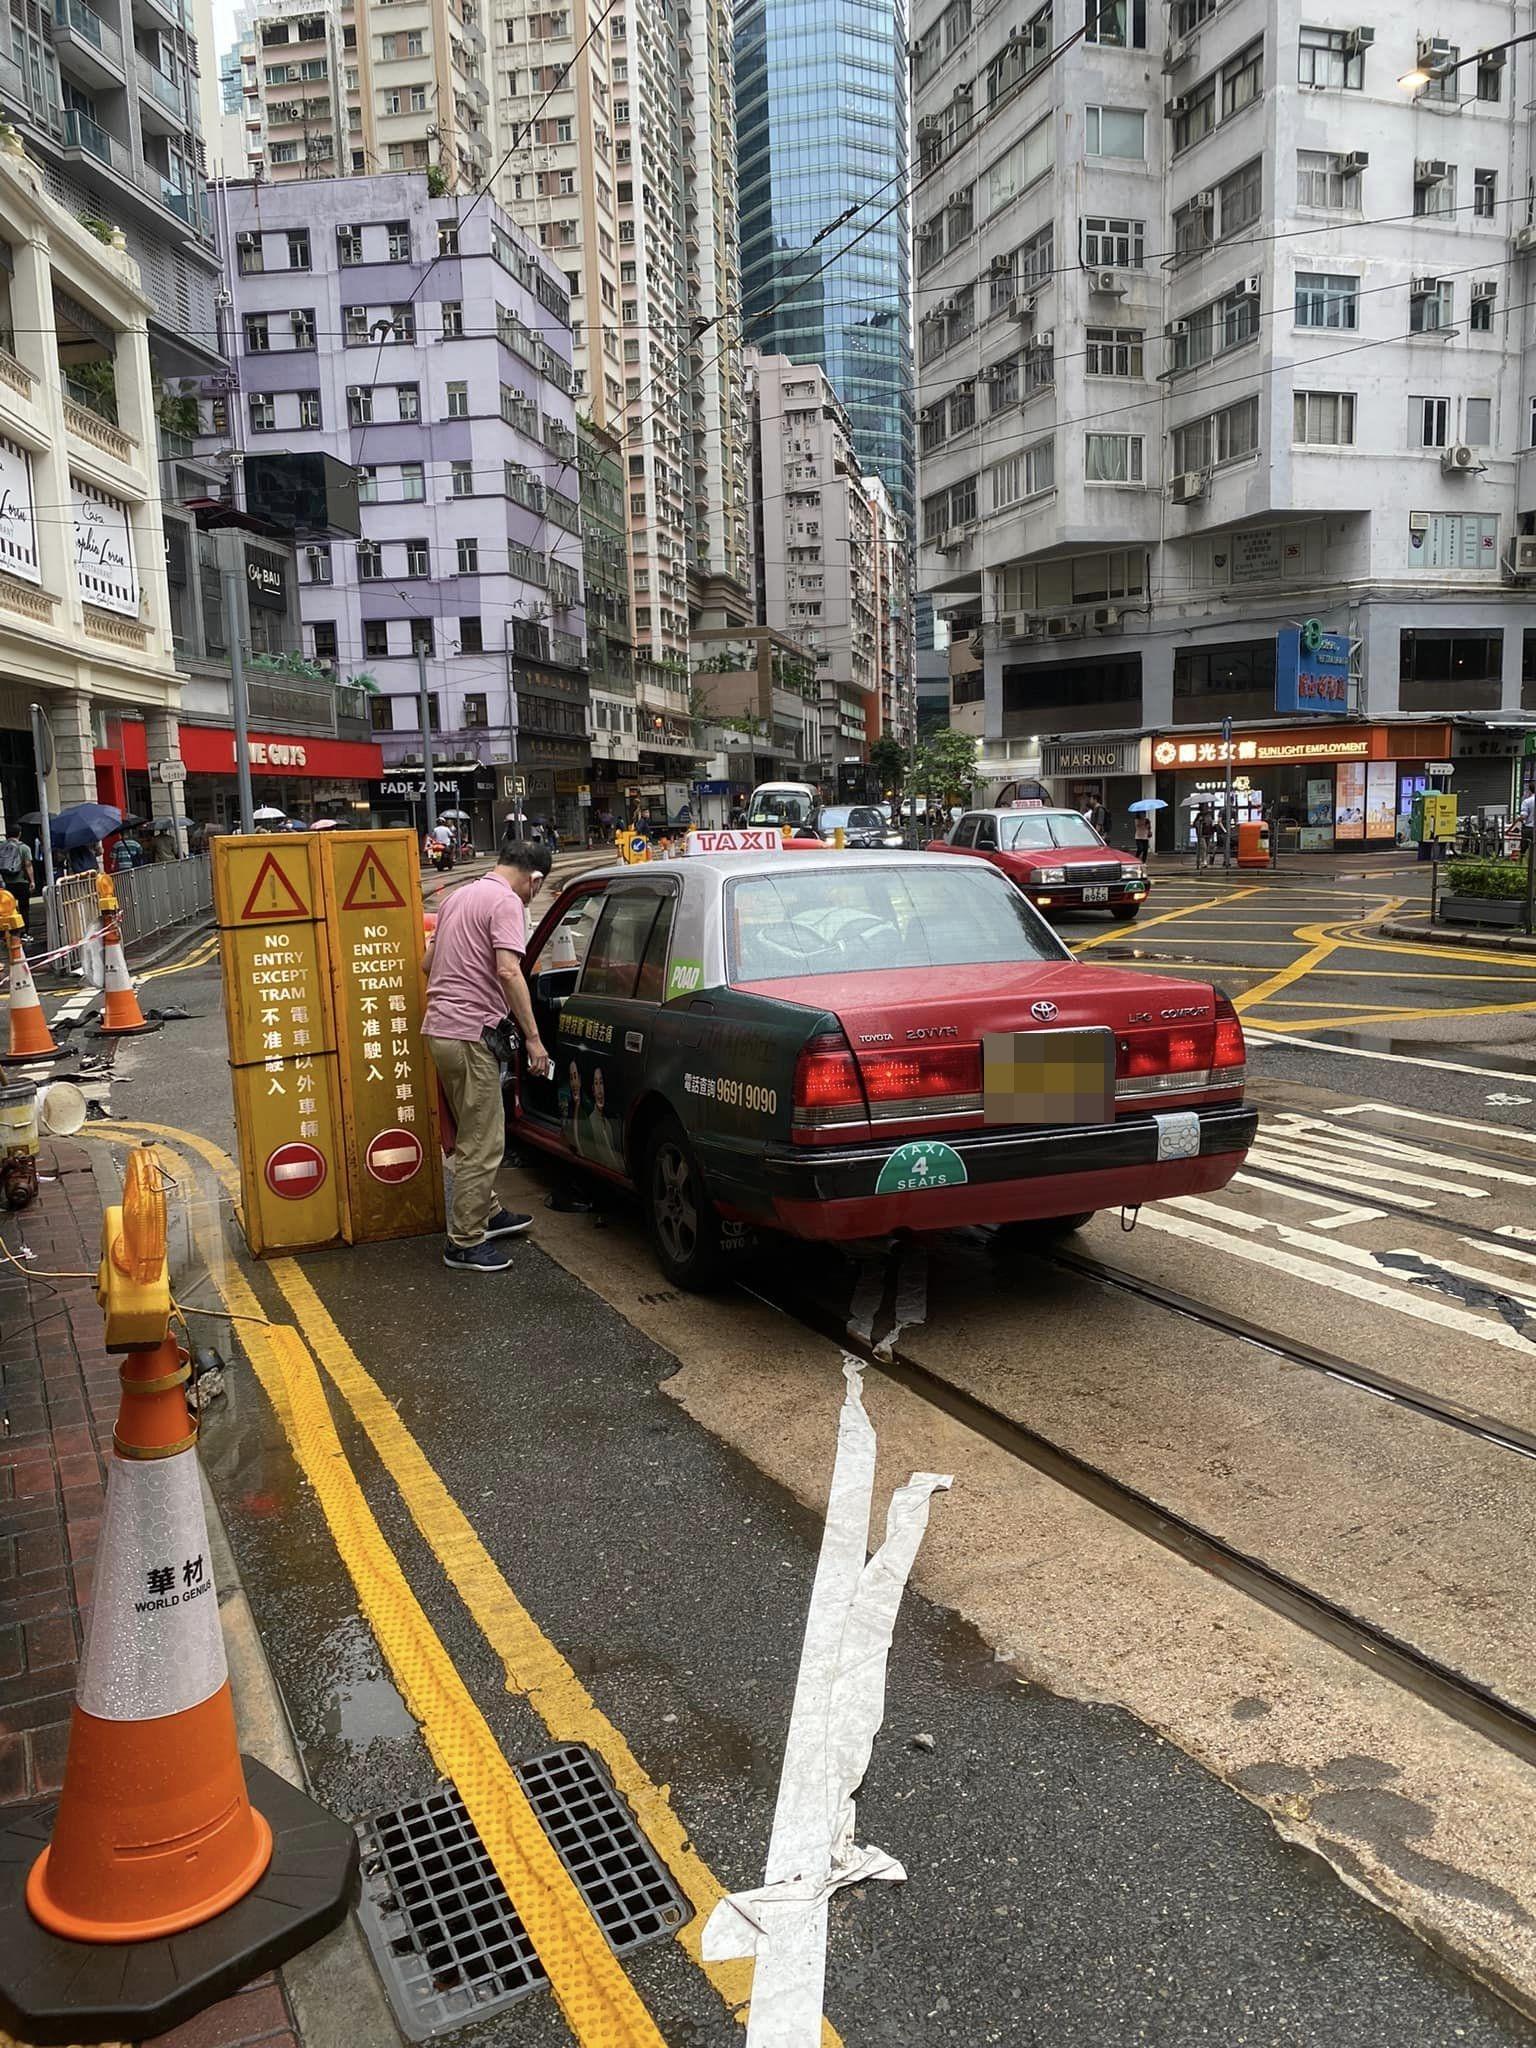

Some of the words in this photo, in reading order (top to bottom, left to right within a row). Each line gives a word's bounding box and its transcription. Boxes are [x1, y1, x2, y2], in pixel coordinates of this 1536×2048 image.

[262, 570, 281, 586] BAU
[268, 743, 307, 766] GUYS
[1258, 744, 1305, 757] SUNLIGHT
[1305, 742, 1368, 754] EMPLOYMENT
[1060, 753, 1116, 767] MARINO
[380, 781, 414, 794] FADE
[697, 831, 776, 851] TAXI
[364, 925, 388, 938] NO
[264, 935, 290, 948] NO
[353, 941, 401, 956] ENTRY
[253, 951, 304, 966] ENTRY
[352, 958, 406, 974] EXCEPT
[252, 968, 309, 985] EXCEPT
[358, 975, 403, 990] TRAM
[259, 987, 306, 1002] TRAM
[360, 997, 384, 1082] 不准駛入
[859, 1033, 894, 1043] TOYOTA
[388, 995, 415, 1123] 電車以外車輛
[897, 1143, 945, 1161] TAXI
[911, 1156, 929, 1176] 4
[897, 1174, 947, 1190] SEATS
[146, 1553, 203, 1596] 華材
[135, 1595, 180, 1613] WORLD
[182, 1578, 212, 1602] GENIUS
